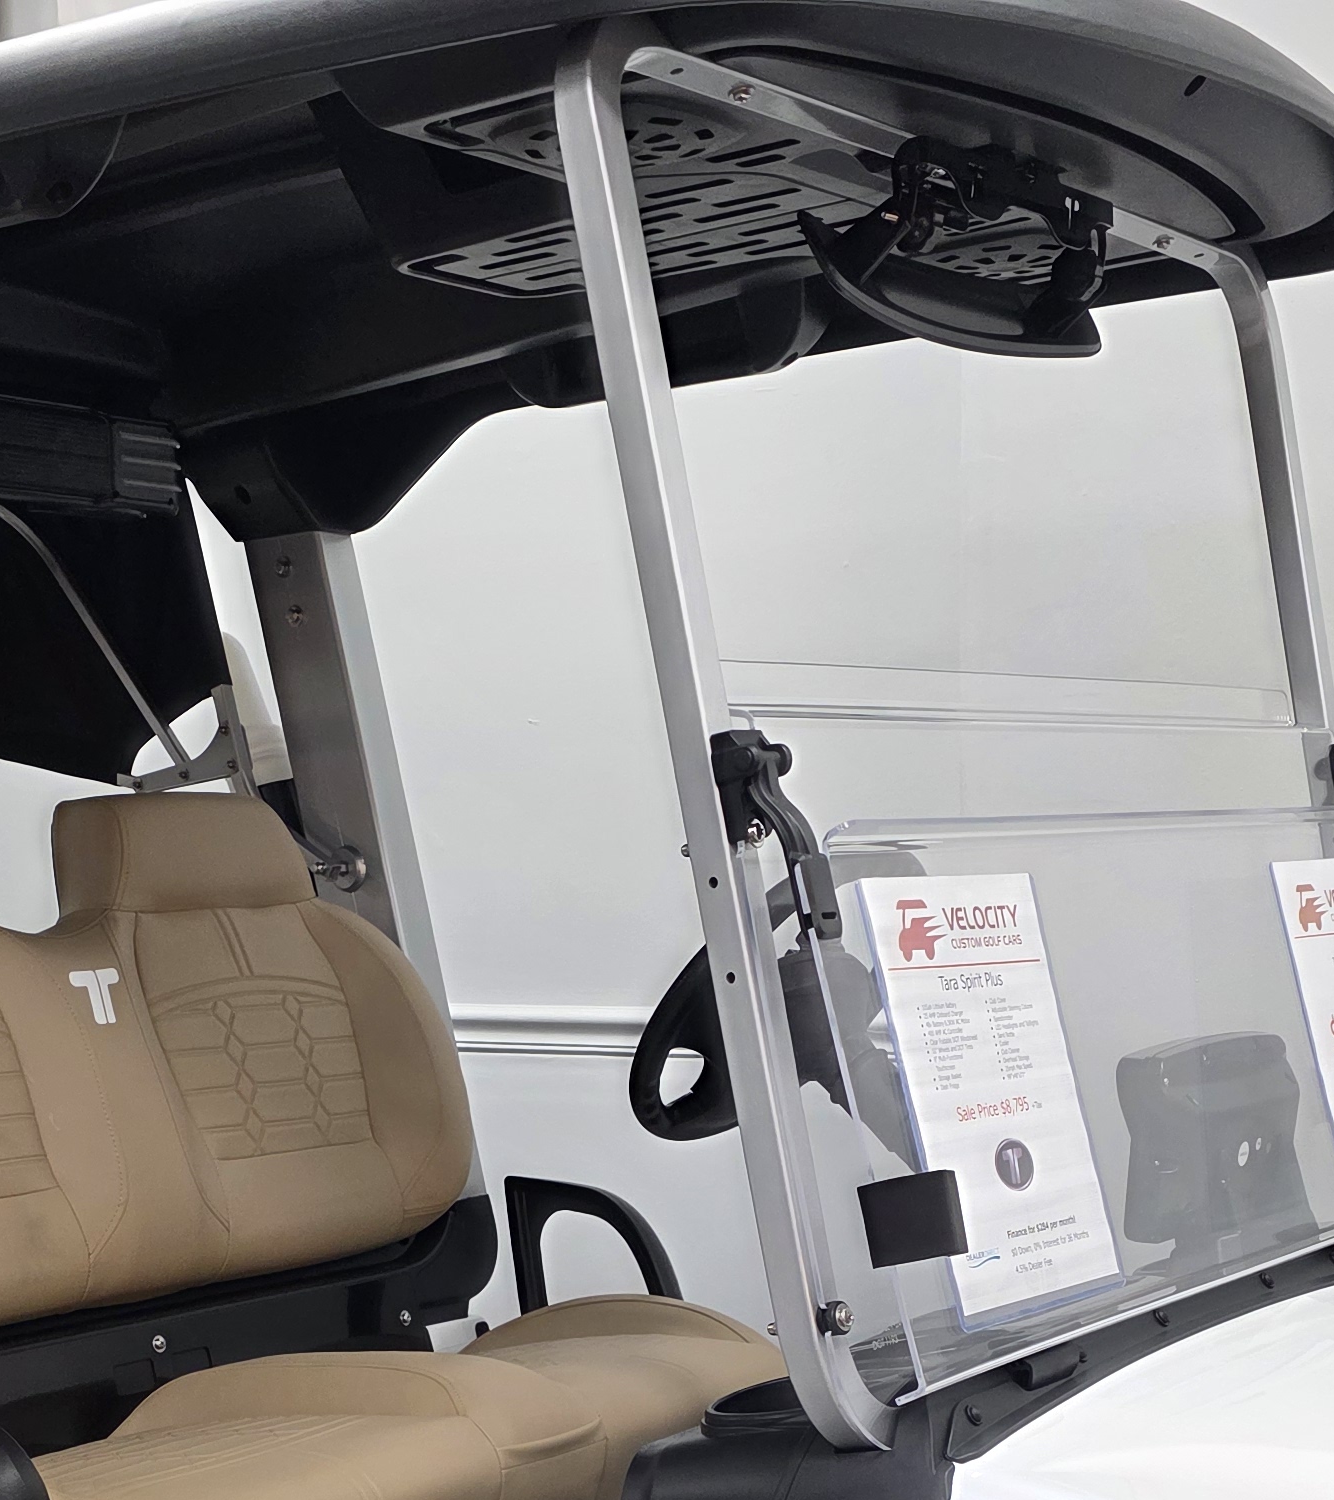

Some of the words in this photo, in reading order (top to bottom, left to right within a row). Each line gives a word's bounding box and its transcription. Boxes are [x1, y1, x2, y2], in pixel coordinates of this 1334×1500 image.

[942, 904, 1017, 931] VELOCITY
[950, 937, 983, 950] CUSTOM
[983, 935, 1002, 947] GOLF
[1002, 934, 1023, 946] CARS
[937, 975, 959, 992] Tara
[959, 972, 984, 993] Spirit
[984, 971, 1004, 988] Plus
[956, 1104, 977, 1122] Sale
[977, 1102, 1000, 1119] Price
[1000, 1096, 1030, 1117] $8,795
